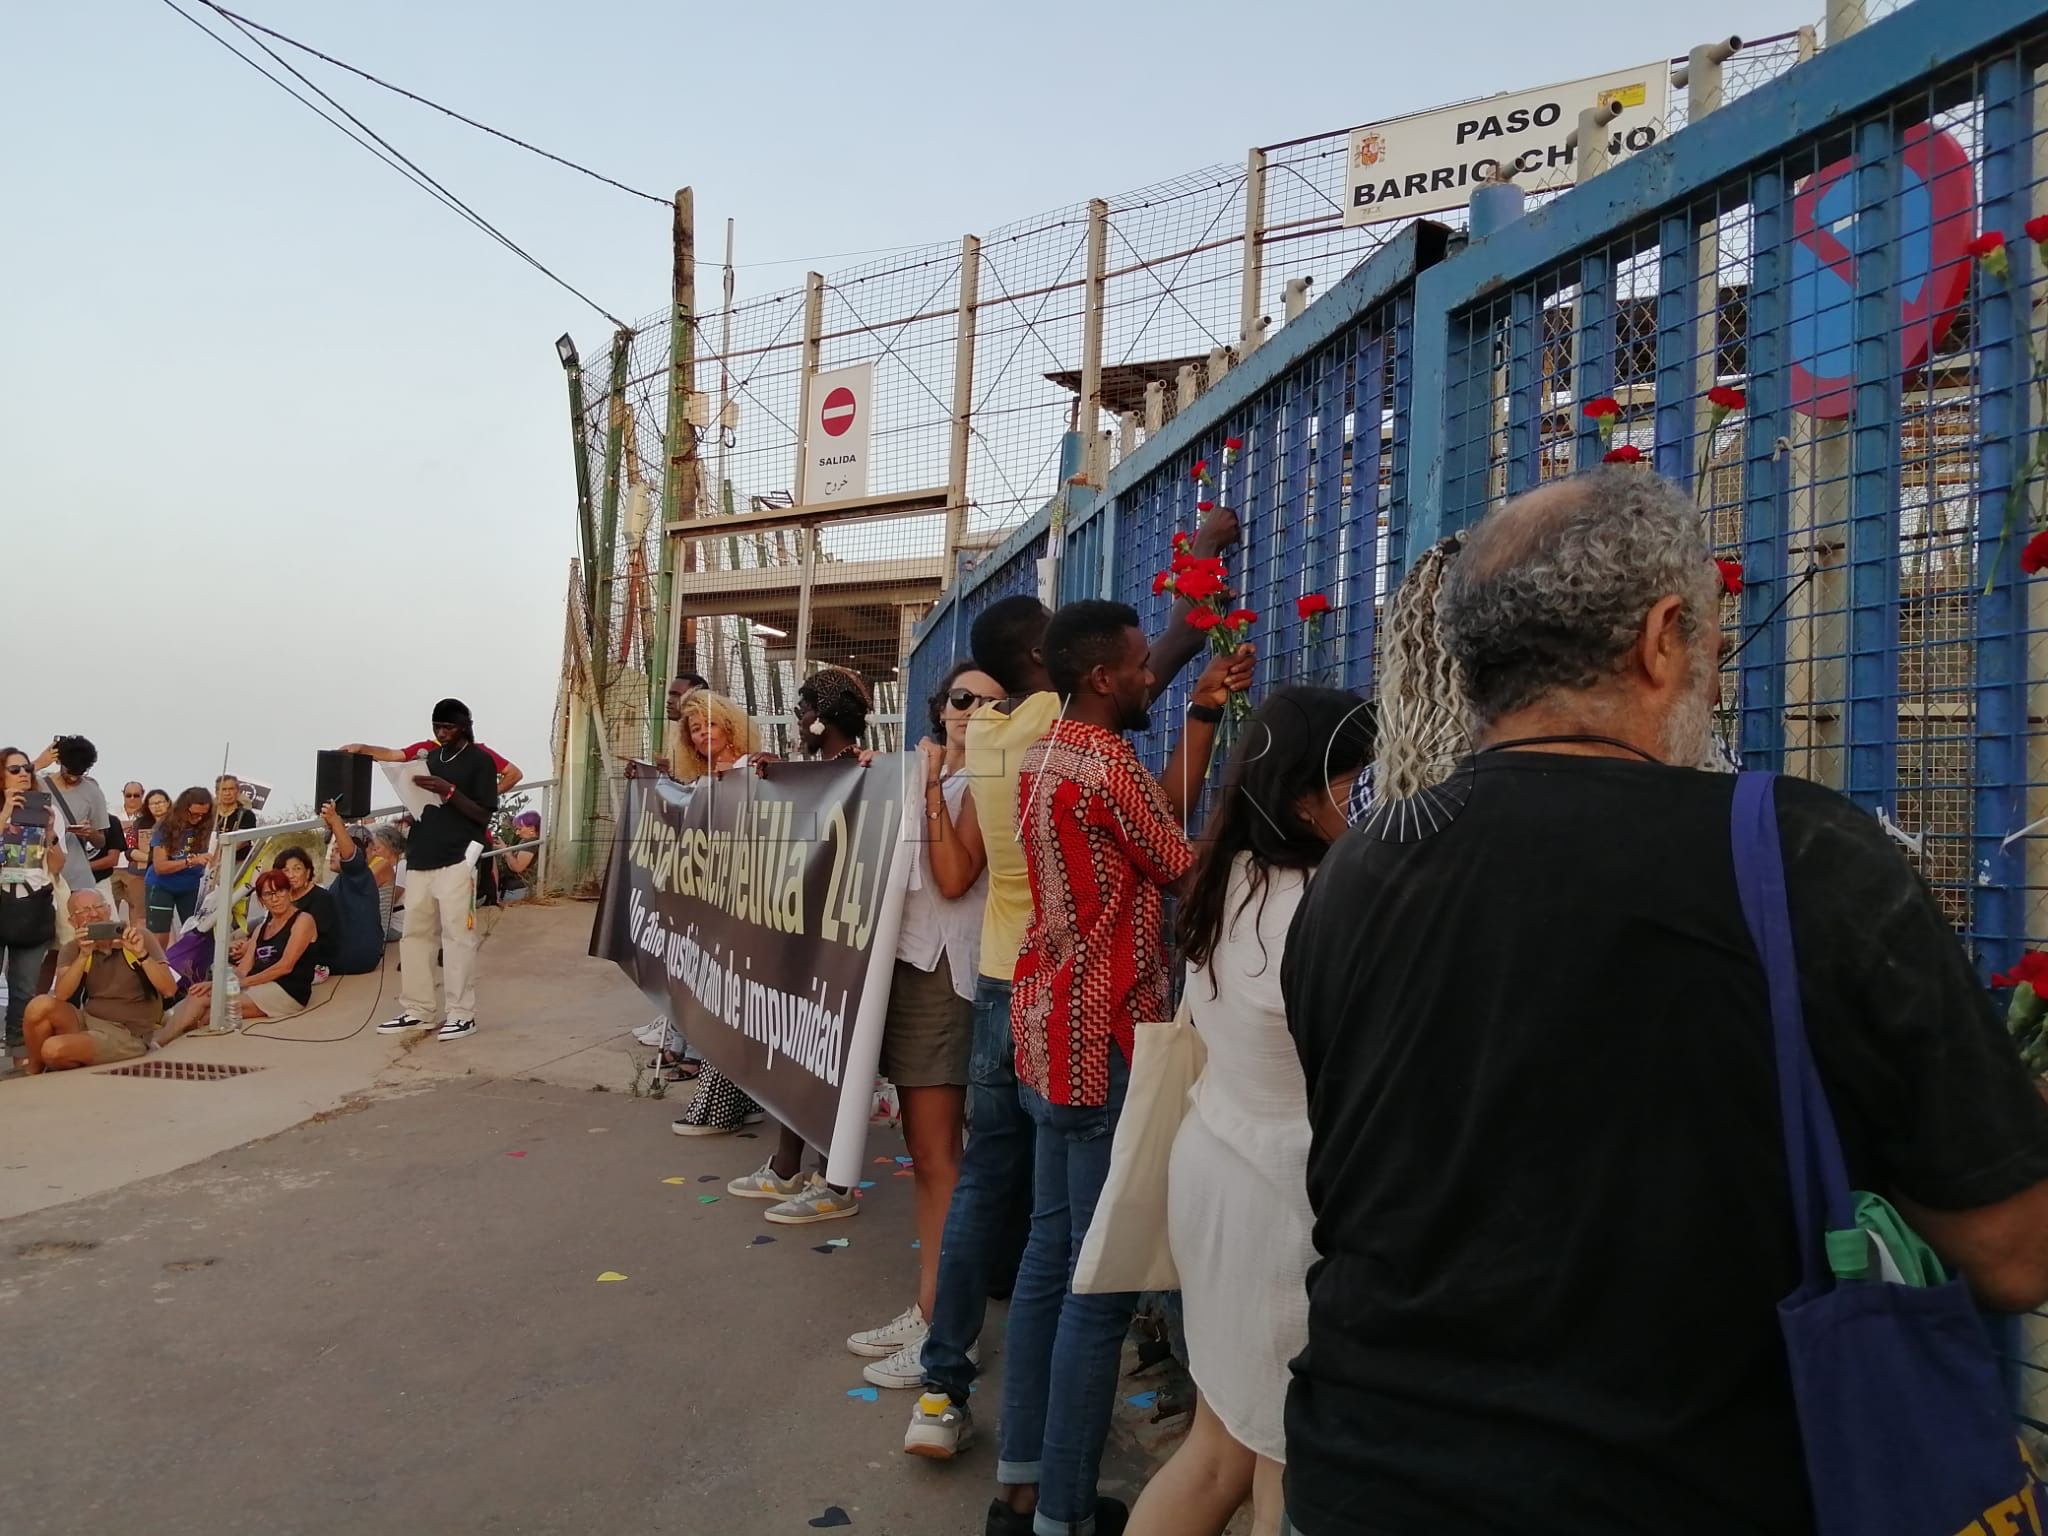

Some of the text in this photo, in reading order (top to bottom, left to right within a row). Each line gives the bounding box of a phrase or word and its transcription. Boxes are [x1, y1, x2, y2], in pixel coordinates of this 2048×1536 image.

[1456, 102, 1561, 146] PASO
[1353, 126, 1656, 207] BARRIO CHNO
[819, 454, 856, 467] SALIDA
[824, 475, 849, 496] خروج
[723, 949, 742, 1030] de
[743, 956, 849, 1088] impunidad
